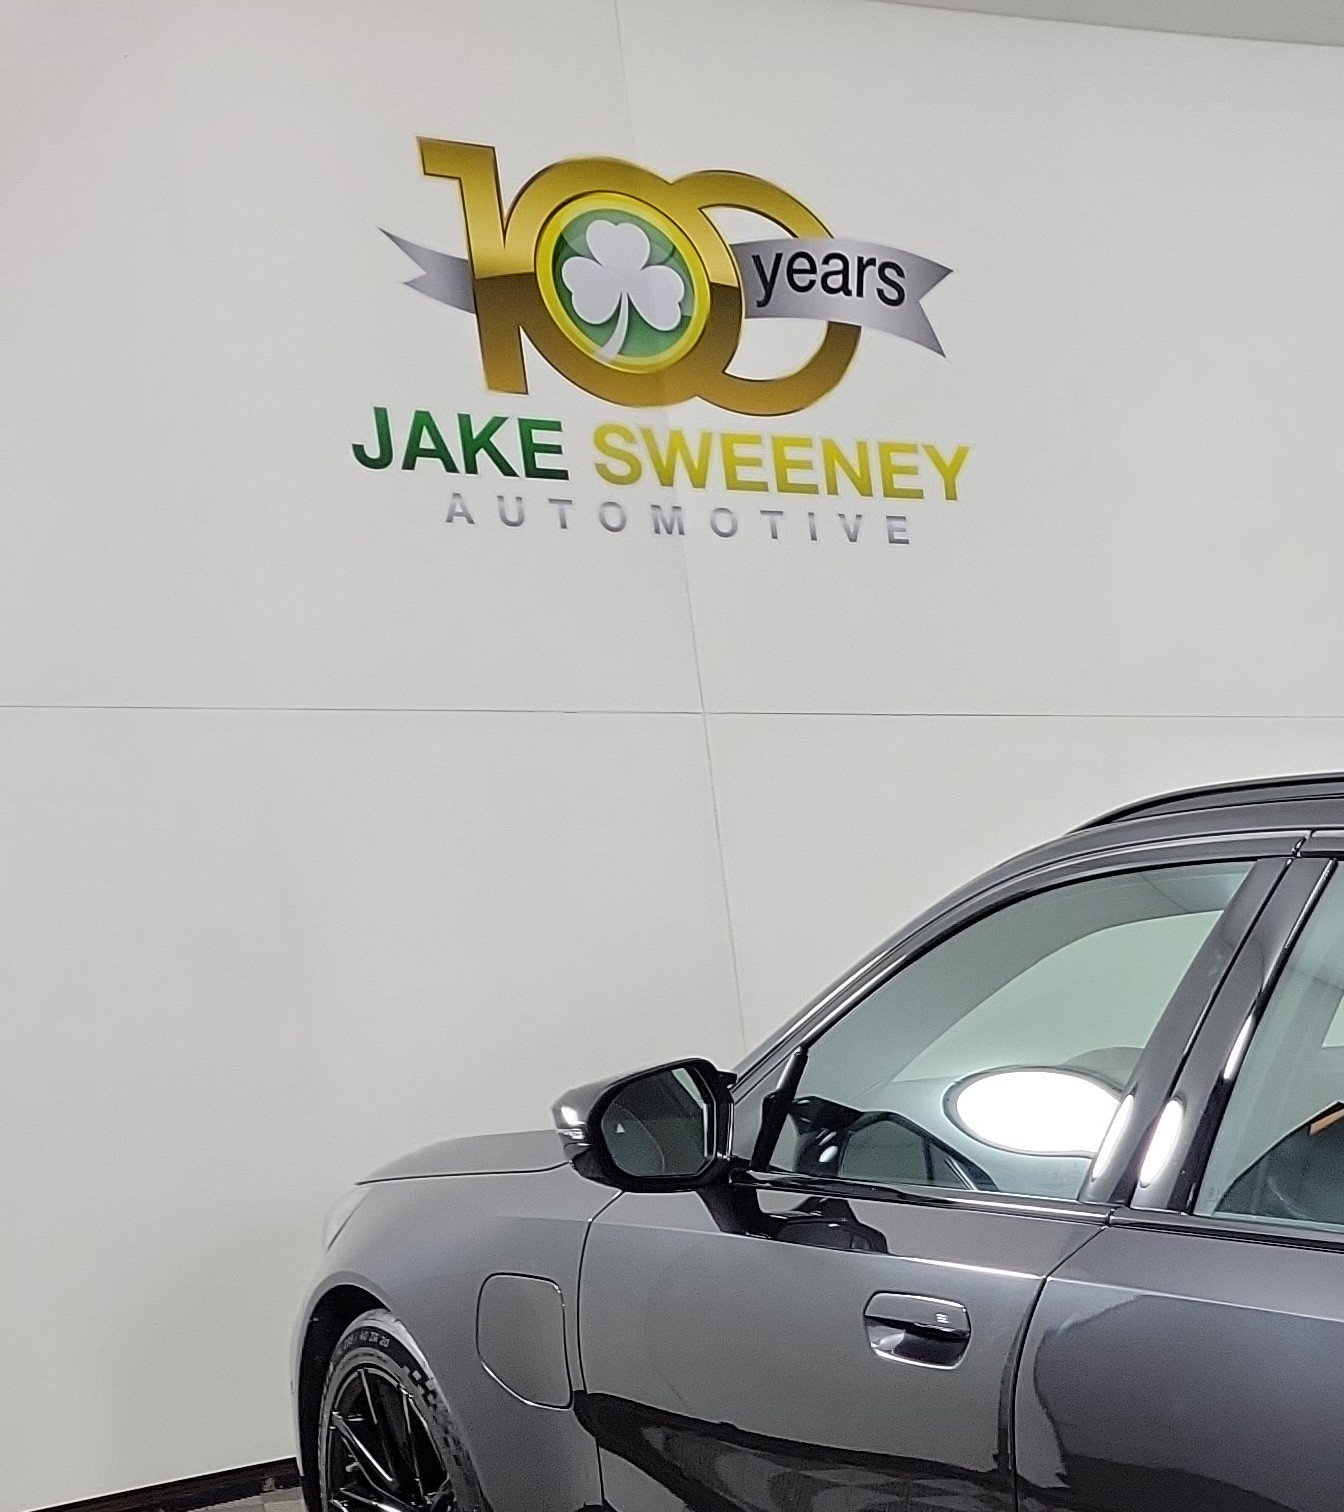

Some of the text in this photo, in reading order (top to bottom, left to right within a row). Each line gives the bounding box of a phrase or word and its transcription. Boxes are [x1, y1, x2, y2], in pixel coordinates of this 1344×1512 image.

[415, 136, 907, 417] 100 years
[351, 406, 970, 502] JAKE SWEENEY
[445, 492, 911, 545] AUTOMOTIVE
